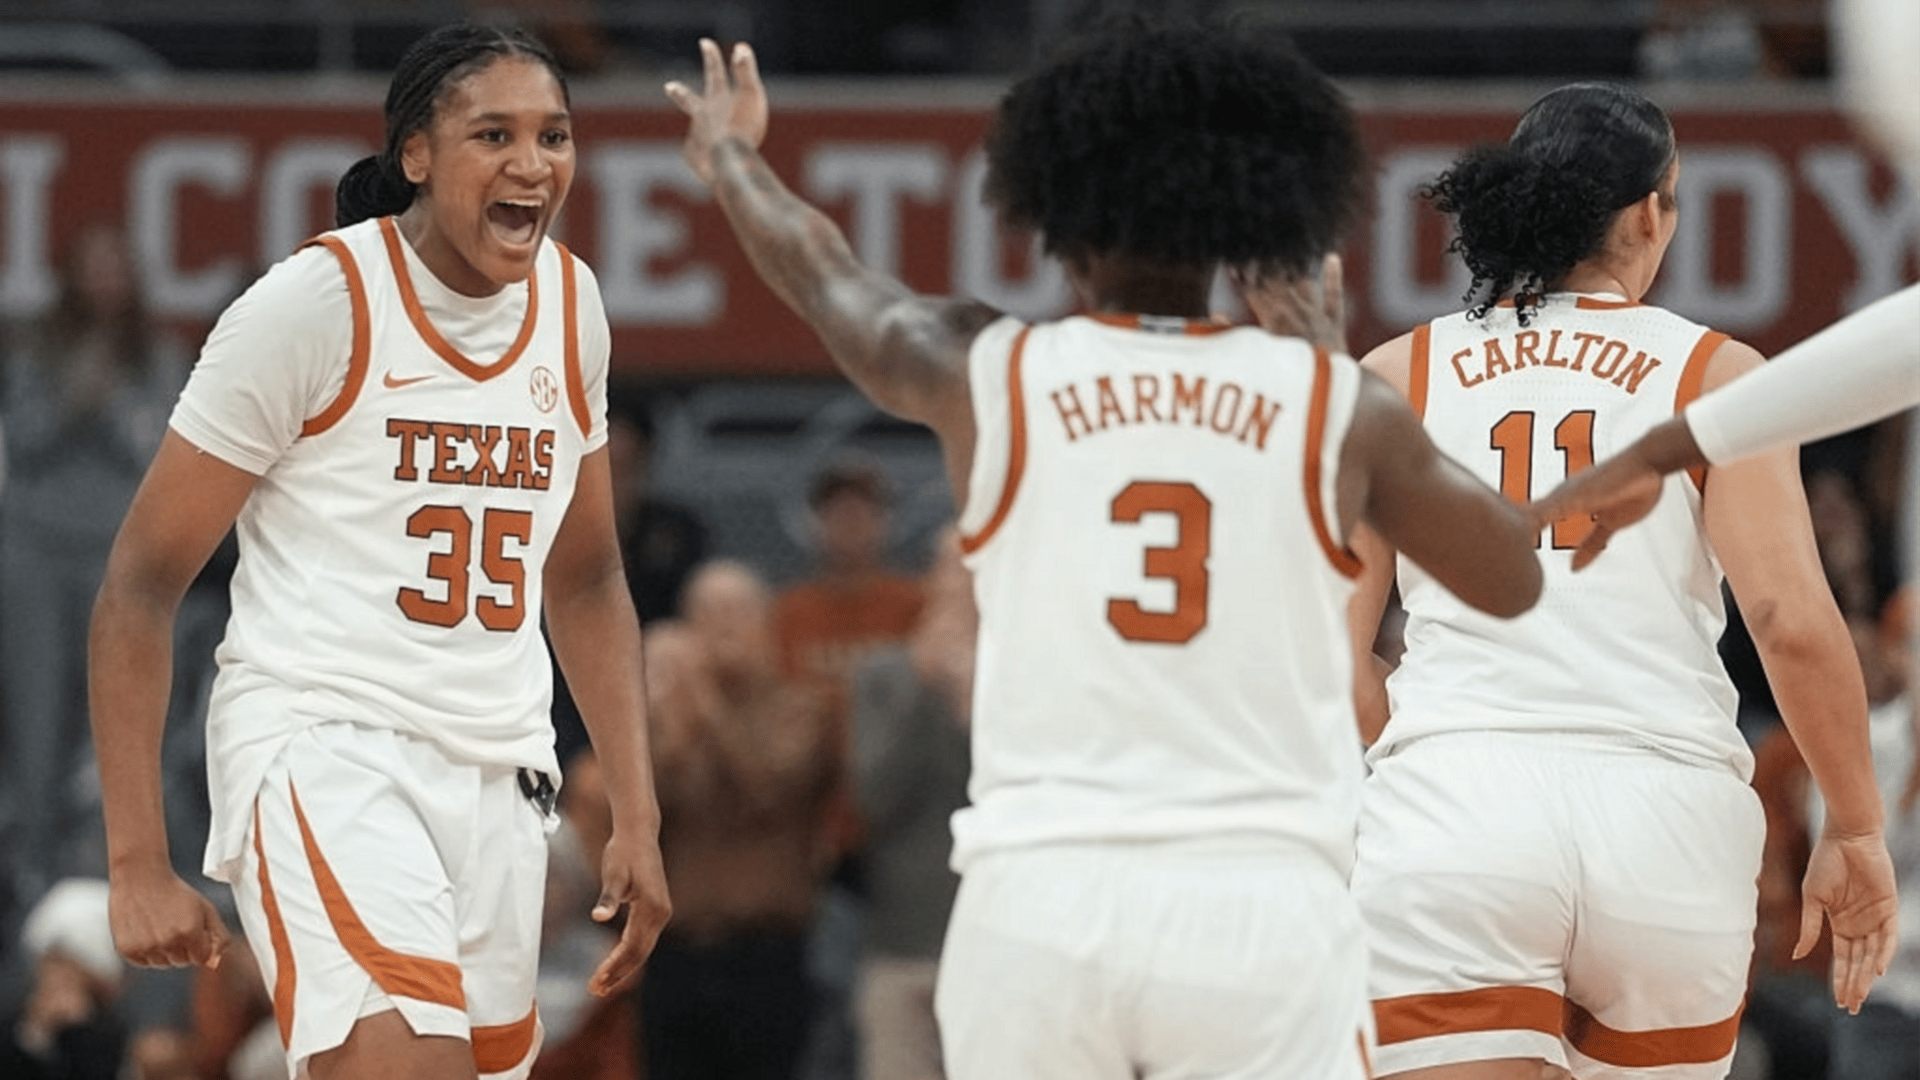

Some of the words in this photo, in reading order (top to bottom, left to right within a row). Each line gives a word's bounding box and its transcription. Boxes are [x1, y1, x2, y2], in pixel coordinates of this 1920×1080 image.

[1450, 329, 1662, 395] CARLTON
[1050, 371, 1282, 453] HARMON
[386, 417, 556, 491] TEXAS
[395, 504, 534, 633] 35
[1106, 479, 1213, 645] 3
